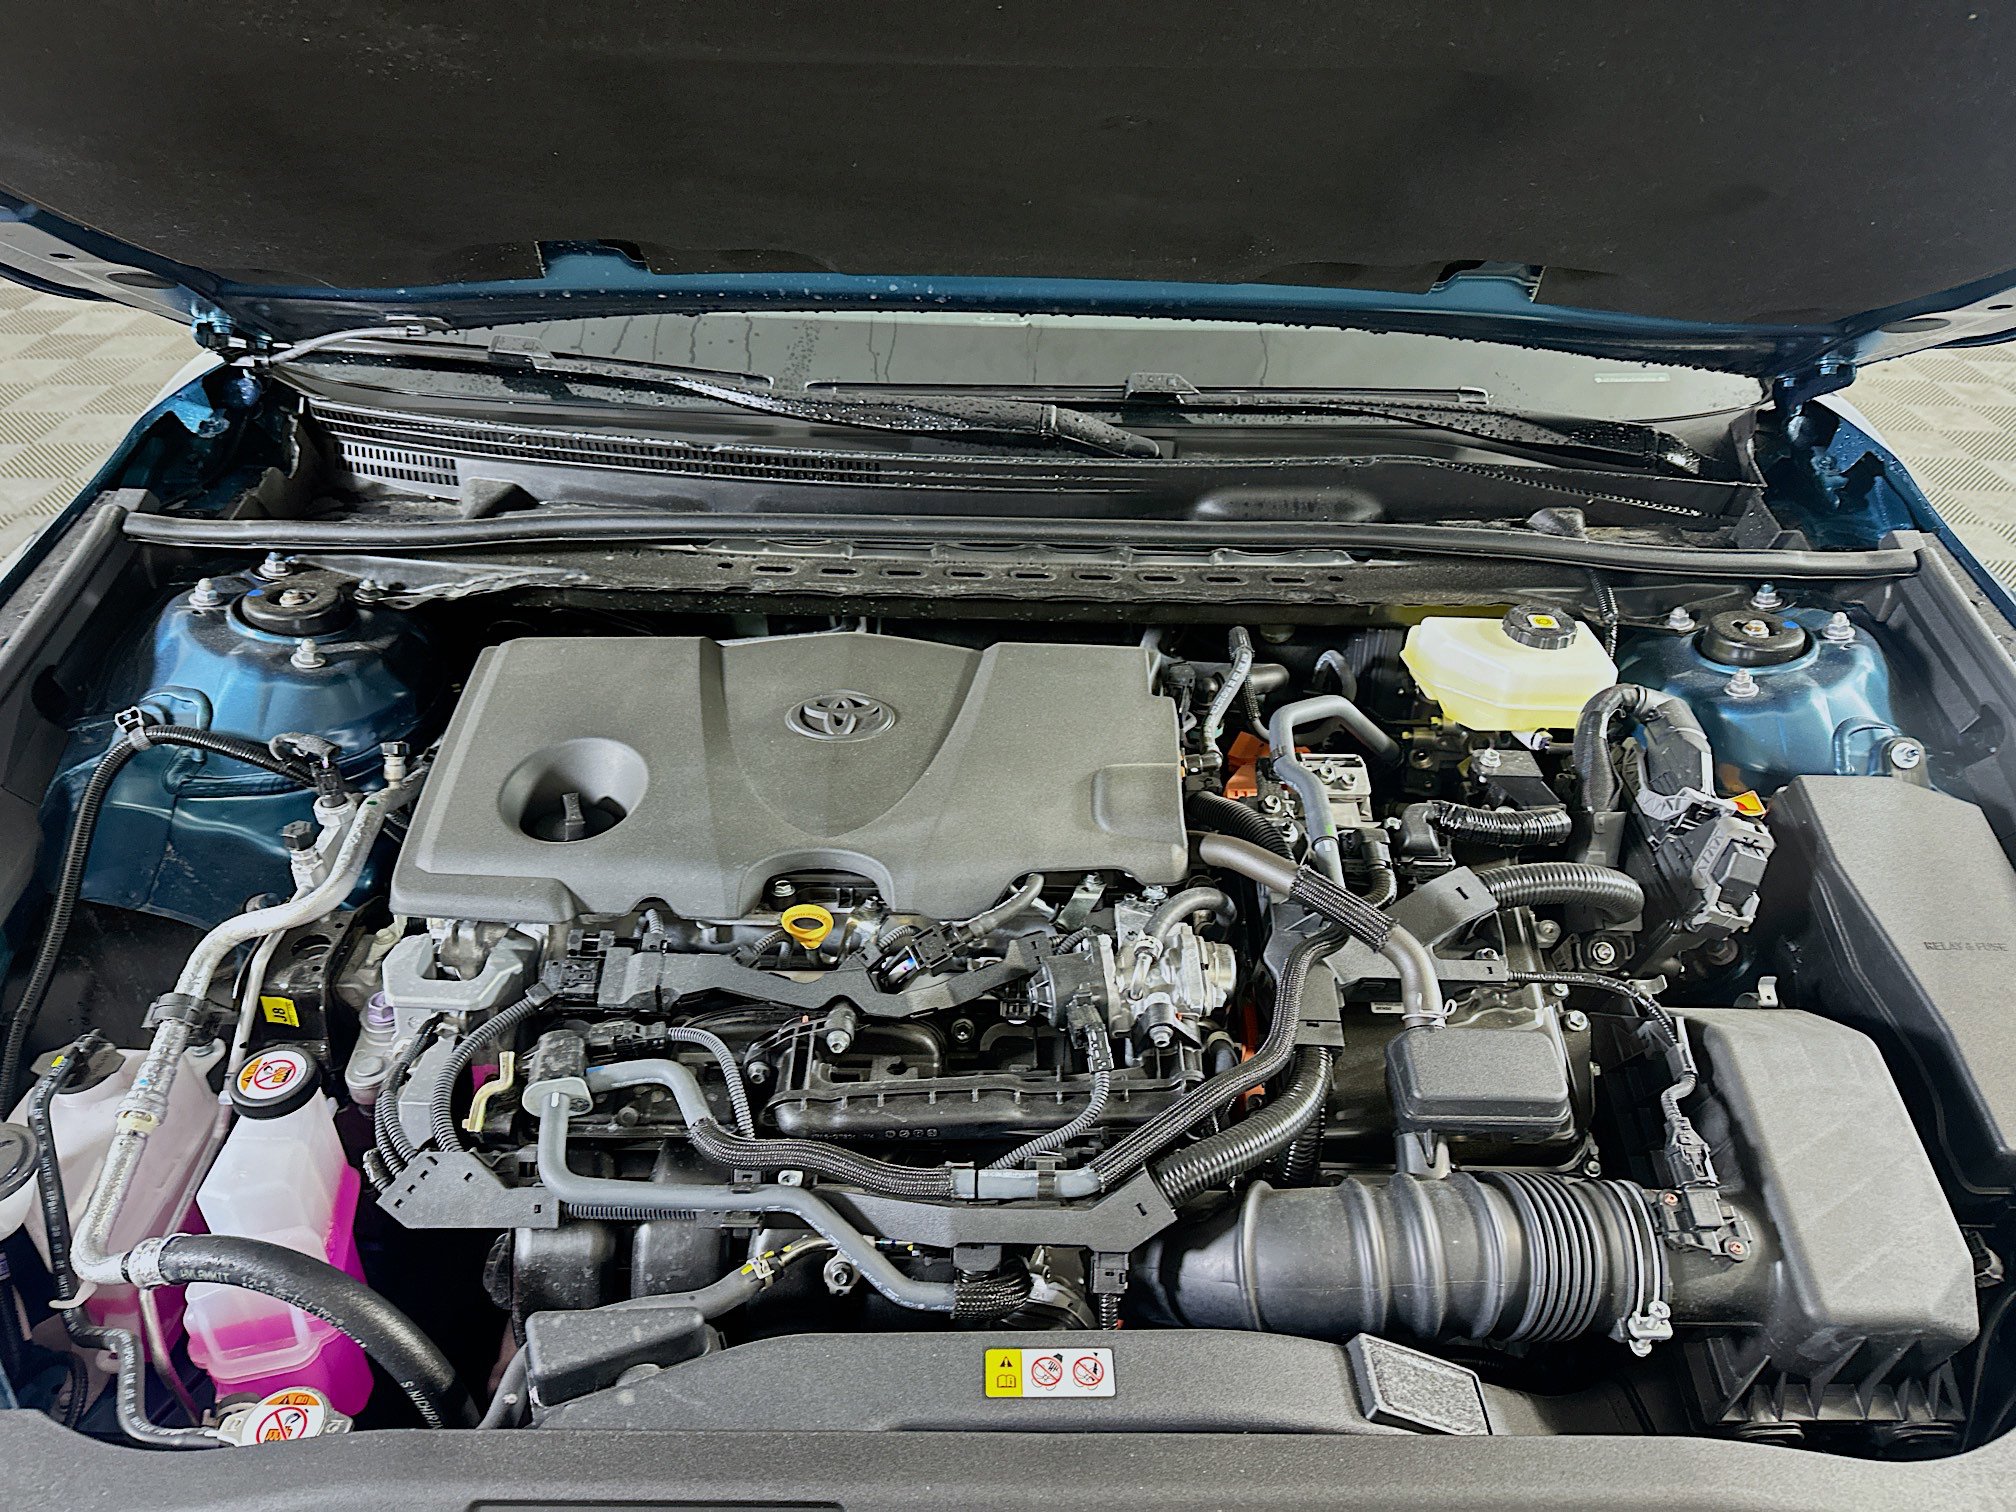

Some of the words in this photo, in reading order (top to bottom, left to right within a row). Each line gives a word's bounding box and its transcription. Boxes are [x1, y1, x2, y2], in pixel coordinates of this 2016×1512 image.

[1923, 941, 1963, 951] RELAY
[1975, 942, 2009, 952] FUSE
[272, 1007, 287, 1022] J8
[41, 1156, 52, 1183] WATER
